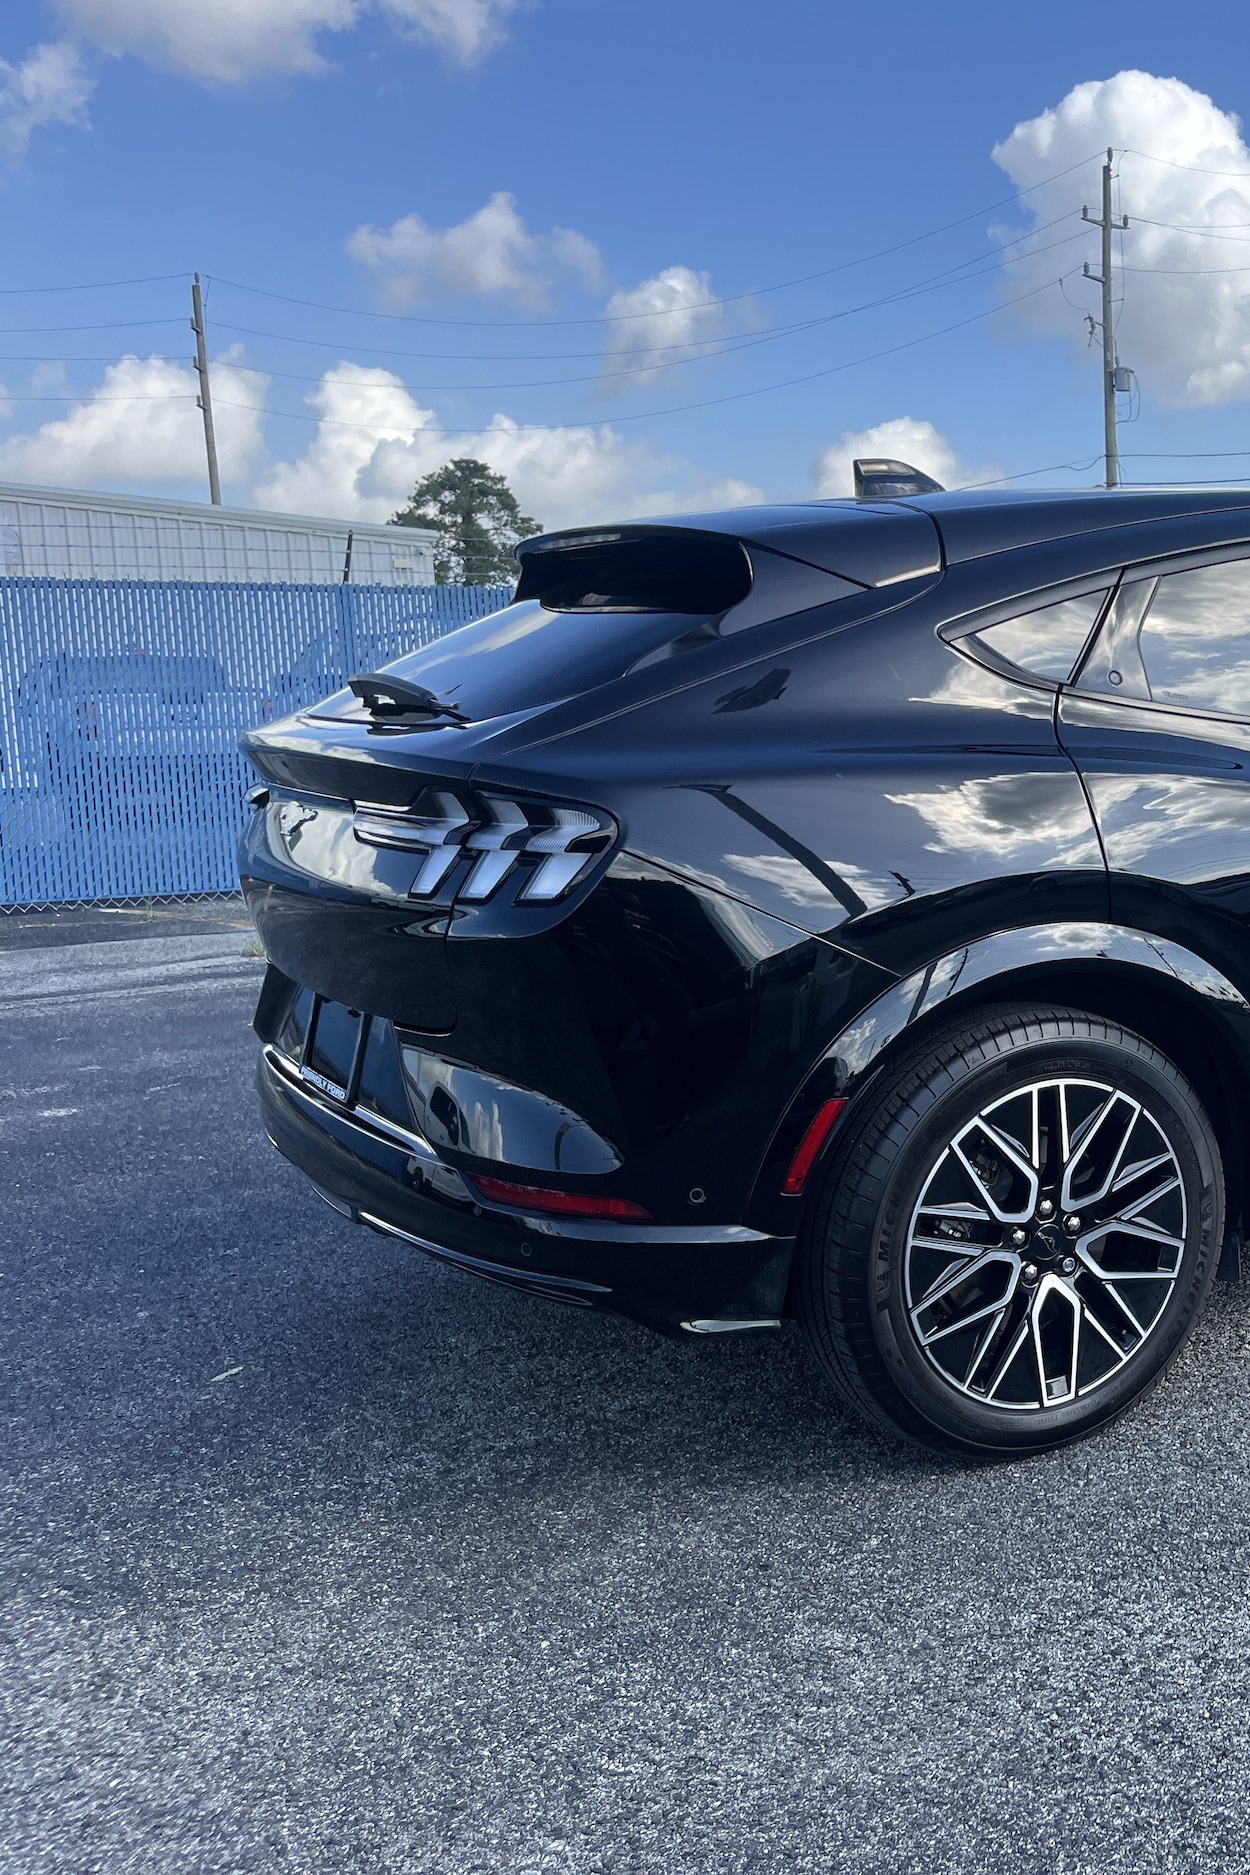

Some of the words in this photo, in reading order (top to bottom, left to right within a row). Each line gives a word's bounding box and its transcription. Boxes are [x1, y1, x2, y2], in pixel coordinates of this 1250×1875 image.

[301, 1066, 328, 1088] FRIENDLY
[327, 1082, 346, 1100] FORD
[1167, 1228, 1211, 1346] MICHELIN
